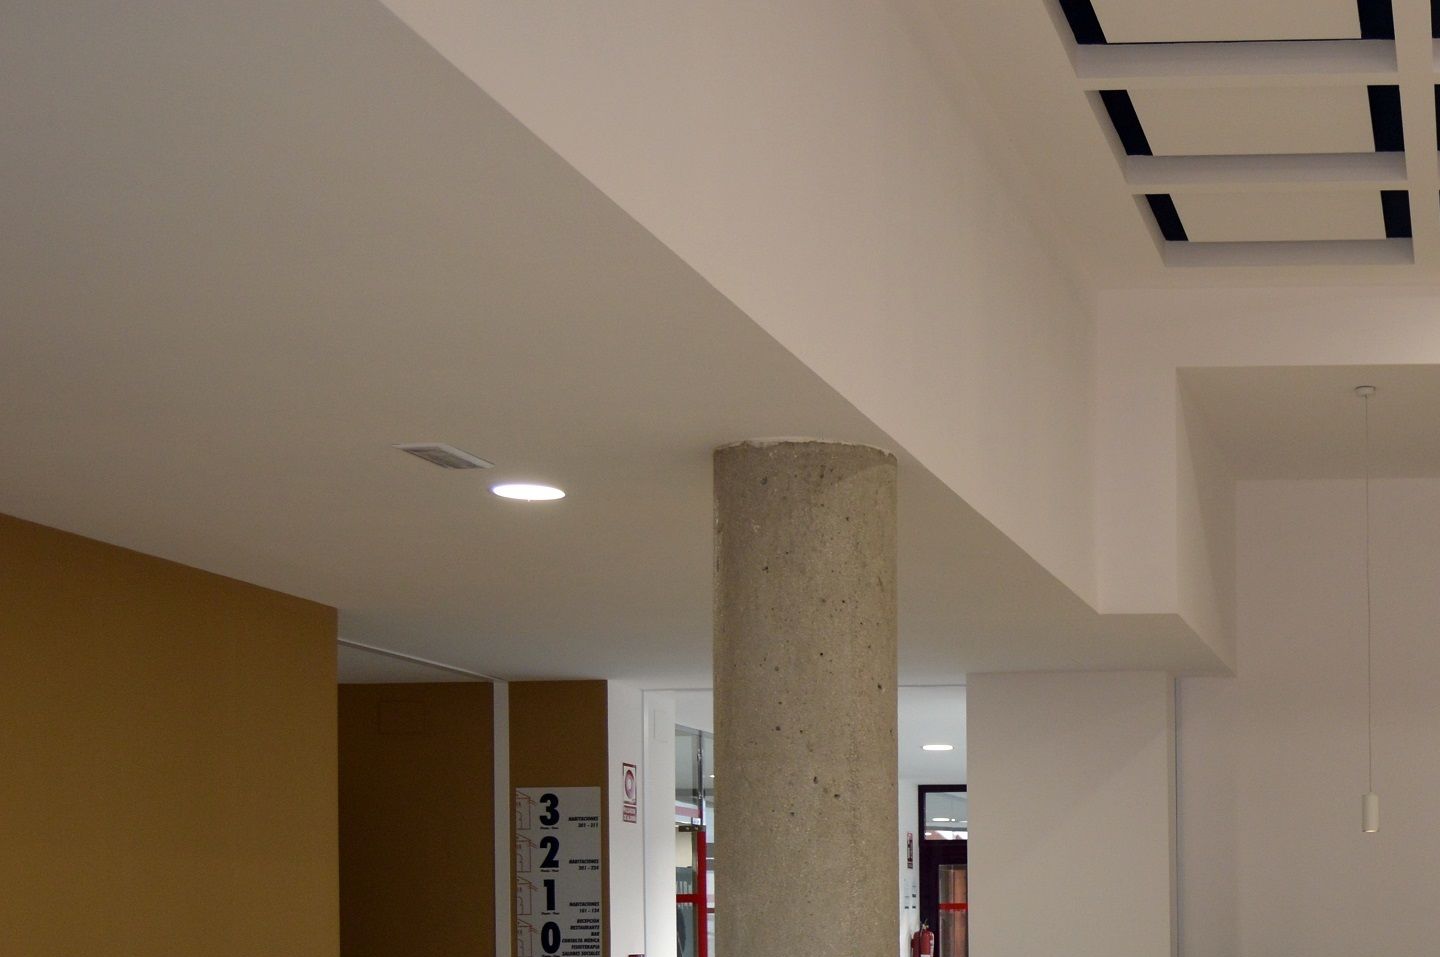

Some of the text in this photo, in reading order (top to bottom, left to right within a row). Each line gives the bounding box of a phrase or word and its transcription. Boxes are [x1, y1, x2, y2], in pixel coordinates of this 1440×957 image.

[540, 793, 560, 826] 3
[540, 836, 560, 869] 2
[543, 879, 556, 911] 1
[541, 921, 561, 954] 0
